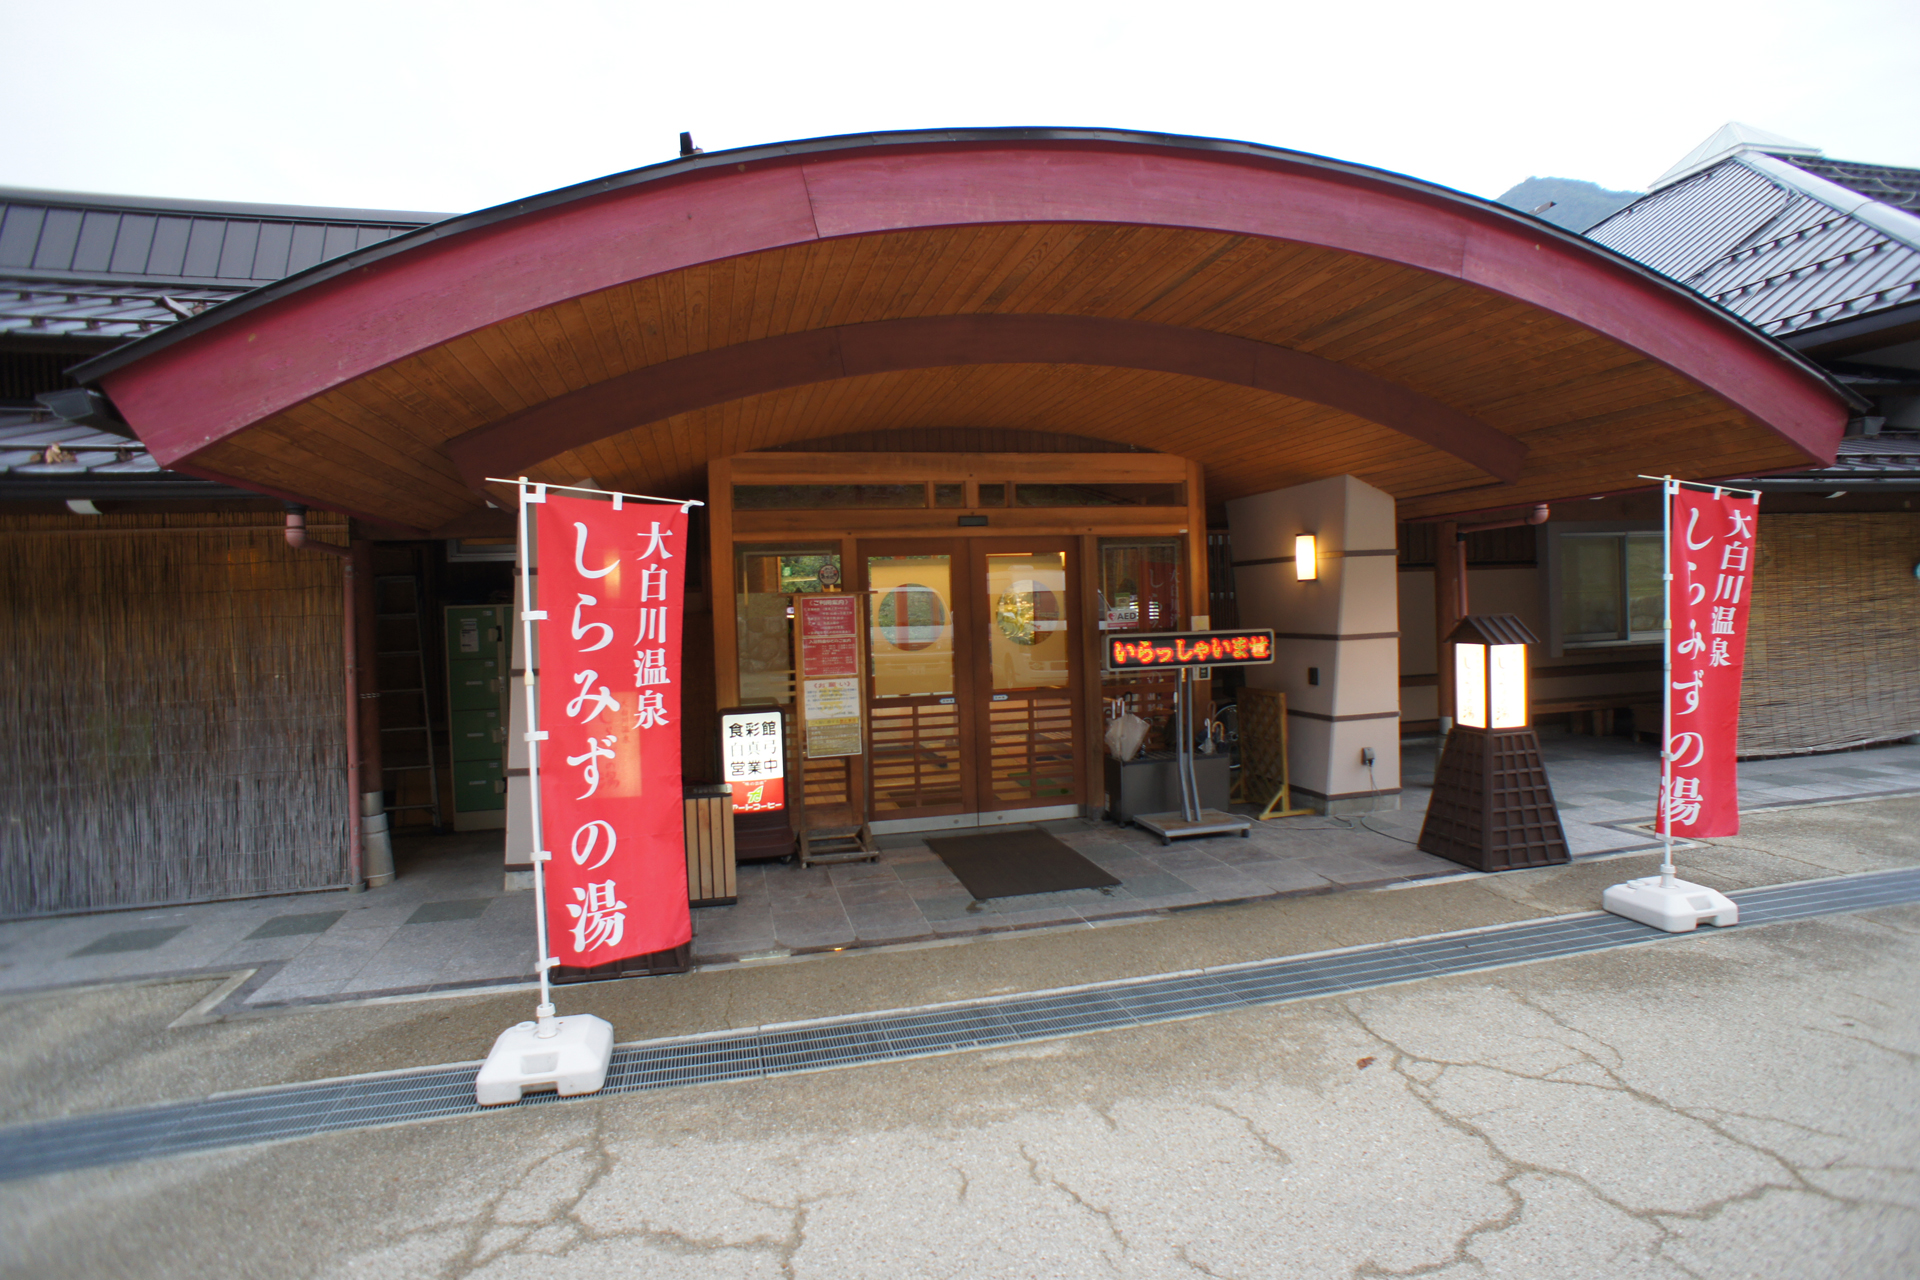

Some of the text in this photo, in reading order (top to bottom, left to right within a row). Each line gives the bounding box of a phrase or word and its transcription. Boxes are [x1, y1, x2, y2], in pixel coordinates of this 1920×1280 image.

[1709, 508, 1752, 668] 大白川温泉
[632, 521, 673, 730] 大白川温泉
[1117, 611, 1136, 620] AED
[1113, 635, 1269, 664] いらっしゃいませ
[1661, 507, 1713, 827] しらみずの湯
[566, 521, 627, 953] しらみずの湯
[729, 720, 776, 738] 食彩館
[730, 758, 778, 776] 営業中
[733, 802, 782, 811] アートコーヒー
